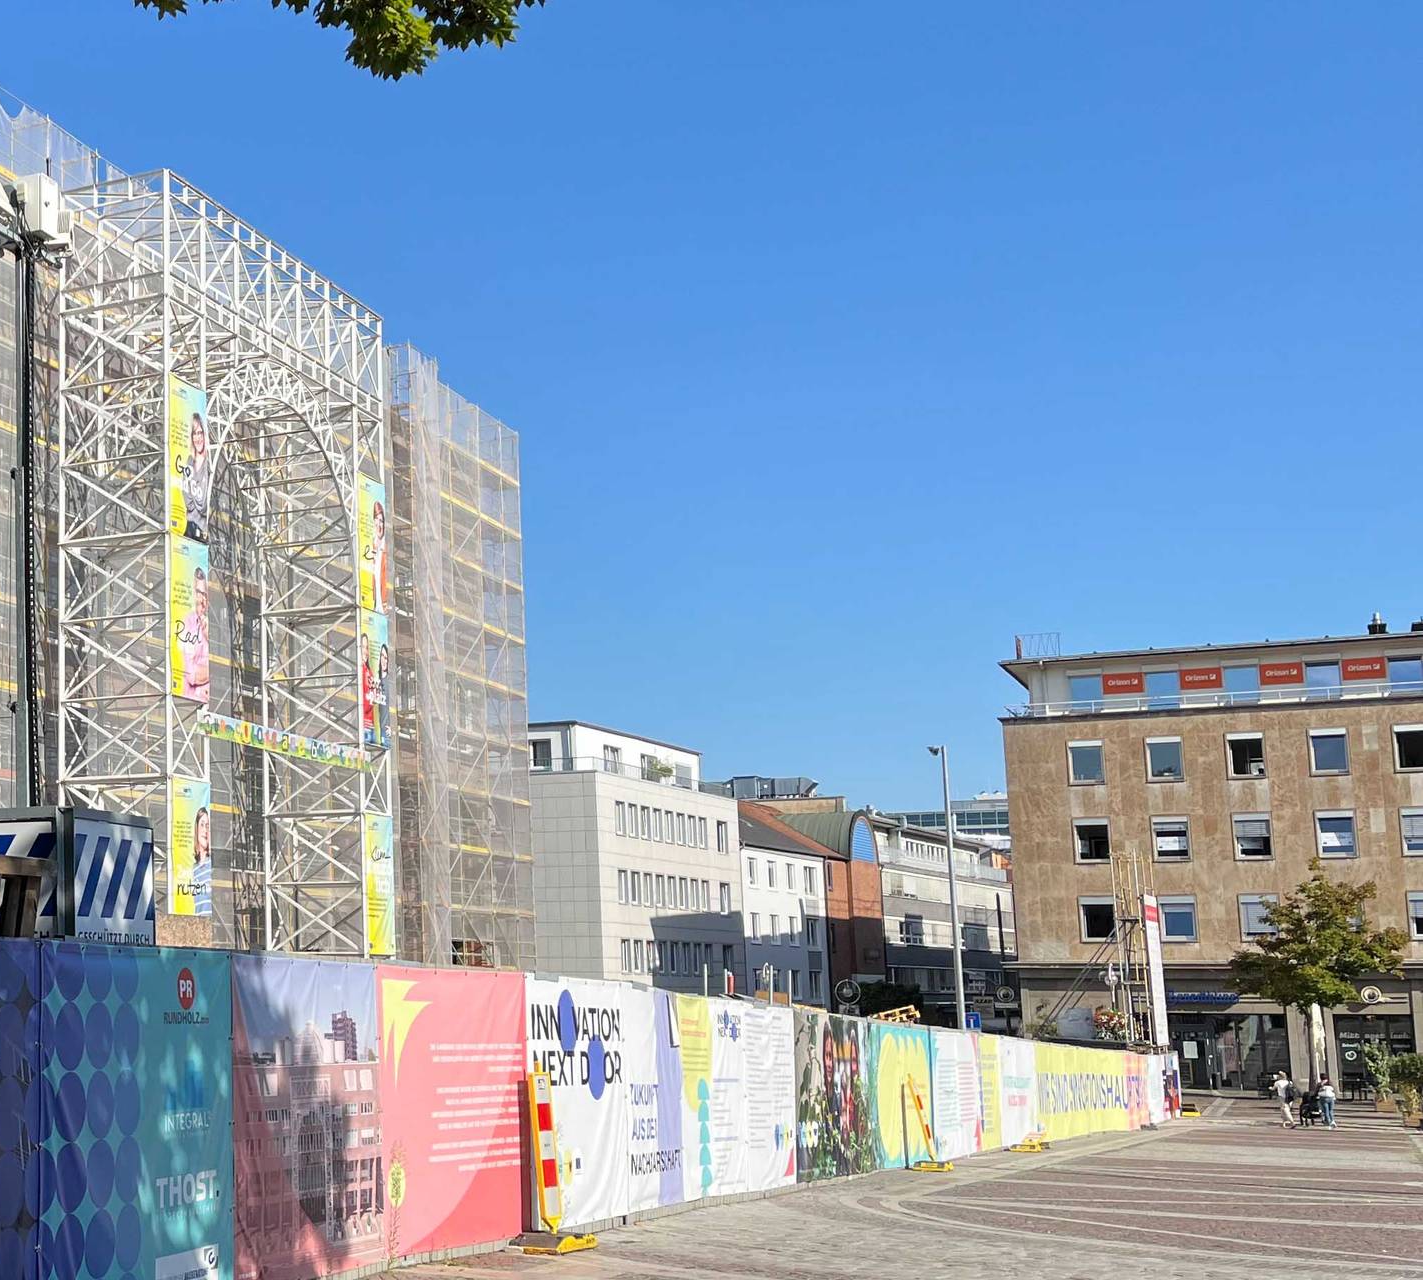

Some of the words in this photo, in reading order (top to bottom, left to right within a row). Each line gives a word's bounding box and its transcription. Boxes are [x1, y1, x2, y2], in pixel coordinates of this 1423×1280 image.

[176, 619, 202, 645] Rad
[1265, 668, 1289, 677] Orizon
[1348, 664, 1371, 672] Orizon
[1185, 674, 1208, 682] Orizon
[1108, 679, 1130, 687] Orizon
[179, 980, 193, 998] PR
[164, 1111, 209, 1133] INTEGRAL
